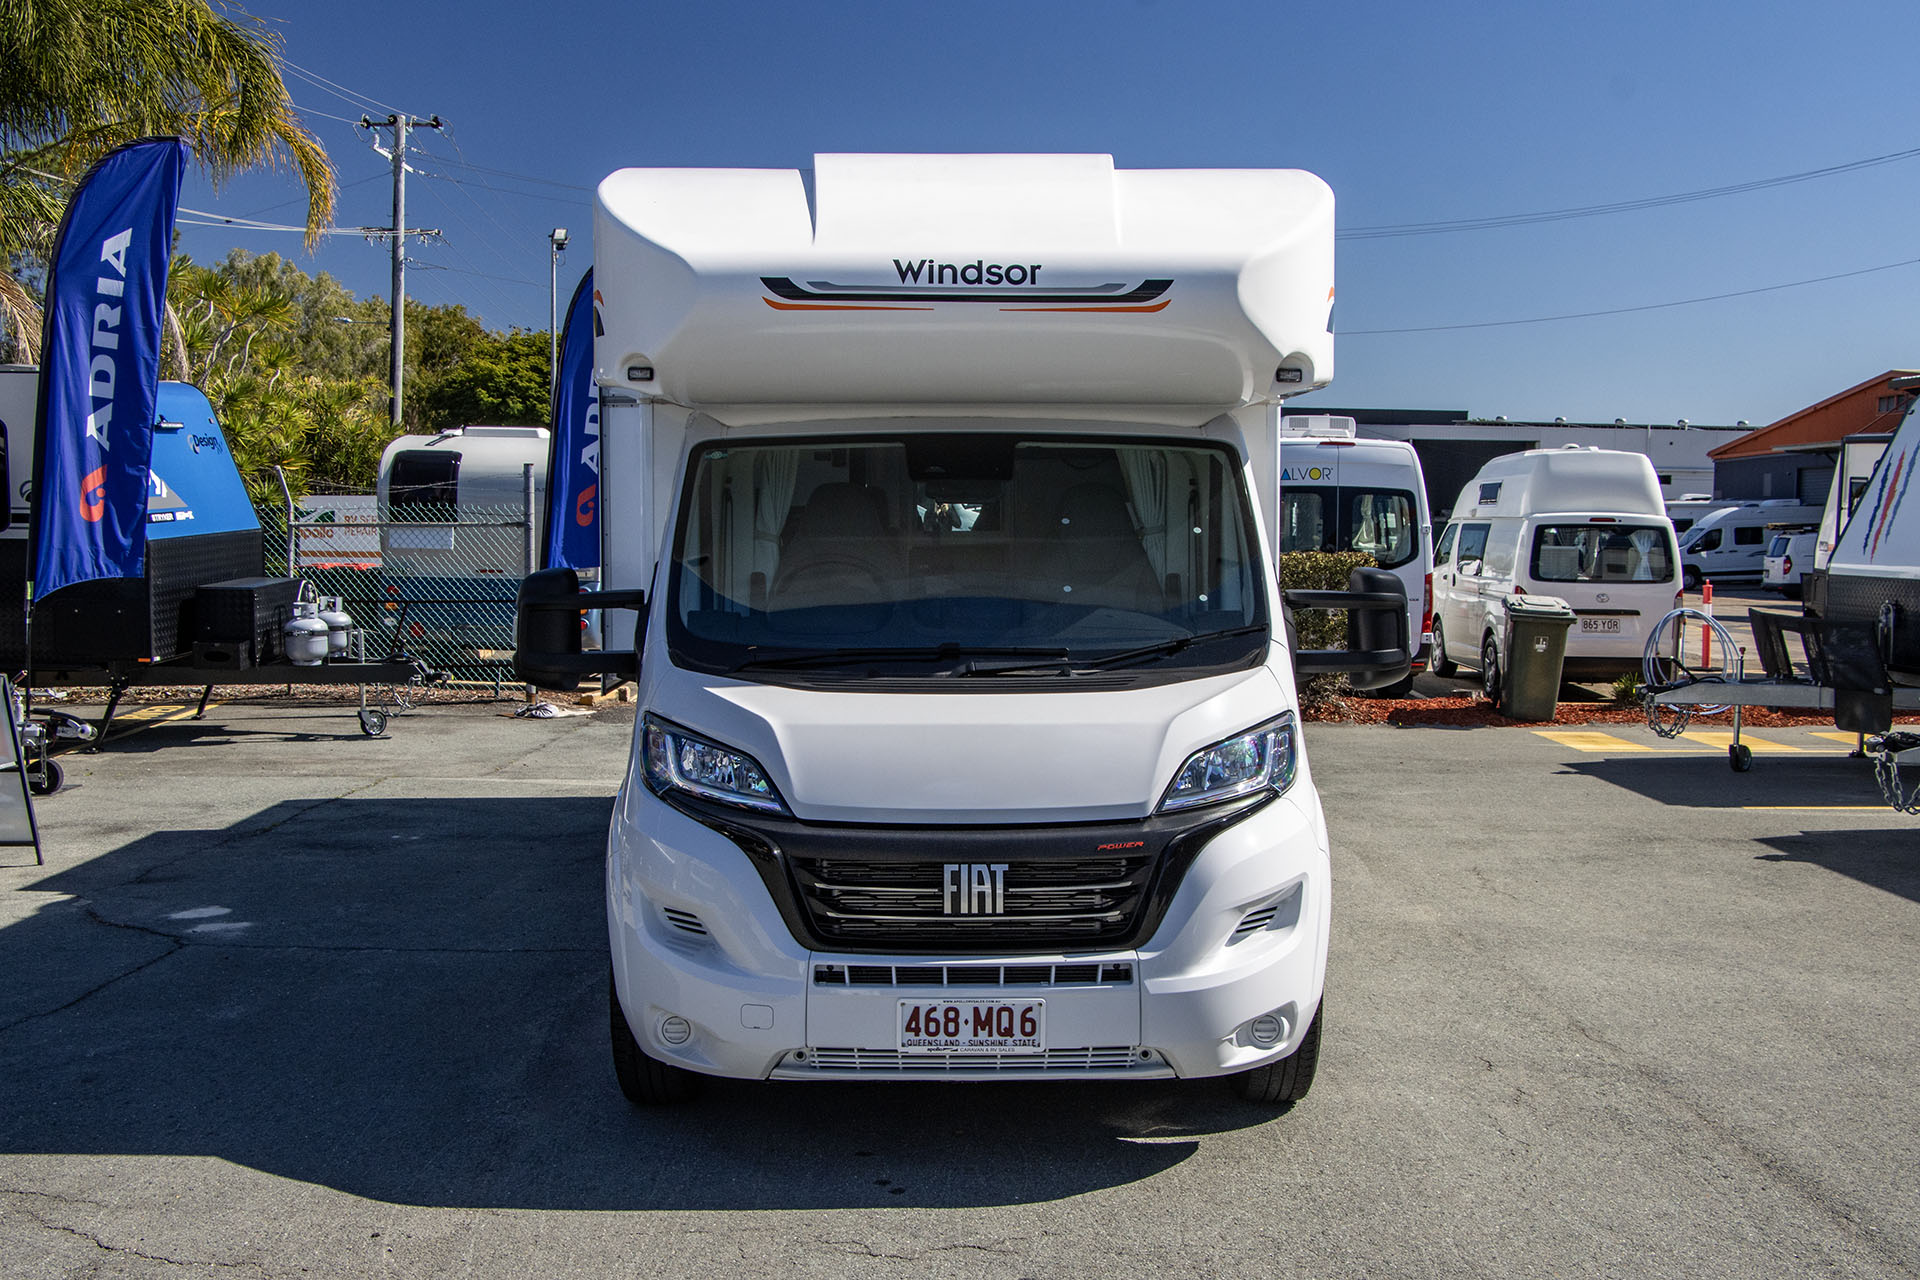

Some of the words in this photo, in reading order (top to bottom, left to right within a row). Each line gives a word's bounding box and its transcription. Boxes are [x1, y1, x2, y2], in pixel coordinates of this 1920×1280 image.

[892, 258, 1042, 286] Windsor
[86, 227, 133, 452] ADRIA
[1097, 841, 1144, 851] POWER
[943, 863, 1009, 914] FIAT
[906, 1039, 960, 1047] QUEENSLAND
[968, 1039, 1008, 1047] SUNSHINE
[1012, 1039, 1036, 1047] STATE
